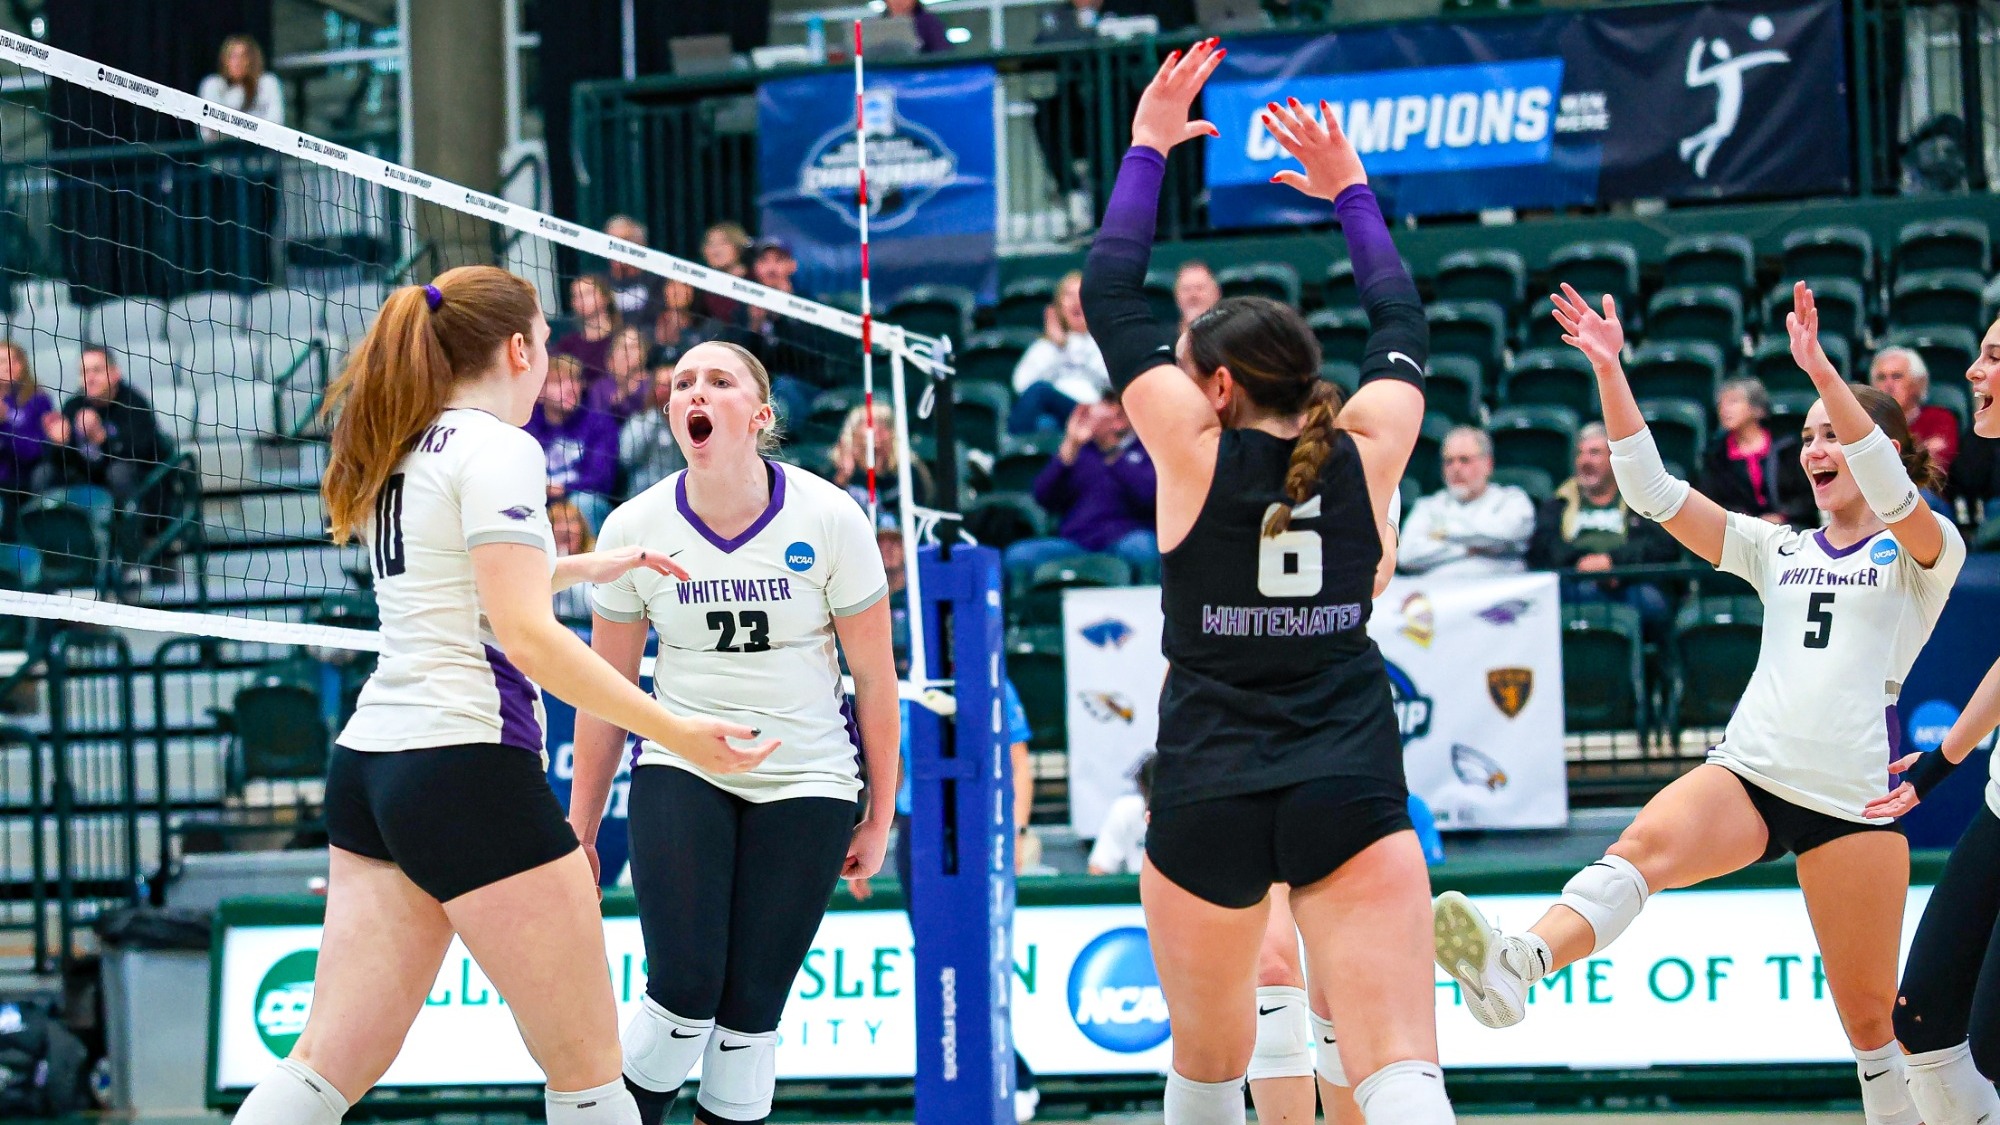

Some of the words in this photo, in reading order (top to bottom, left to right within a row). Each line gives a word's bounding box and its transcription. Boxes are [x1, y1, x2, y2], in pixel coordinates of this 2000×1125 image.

[16, 41, 49, 60] CHAMPIONSHIP
[105, 71, 128, 88] VOLLEYBALL
[128, 79, 159, 98] CHAMPIONSHIP
[209, 107, 230, 123] VOLLEYBALL
[231, 115, 258, 131] CHAMPIONSHIP
[375, 473, 406, 579] 10
[1258, 494, 1323, 597] 6
[1873, 549, 1896, 560] NCAA
[788, 555, 813, 565] NCAA
[1779, 567, 1878, 587] WHITEWATER
[676, 578, 792, 604] WHITEWATER
[706, 611, 771, 652] 23
[1803, 592, 1836, 649] 5
[1647, 956, 1734, 1002] OF
[1076, 985, 1170, 1024] NCA
